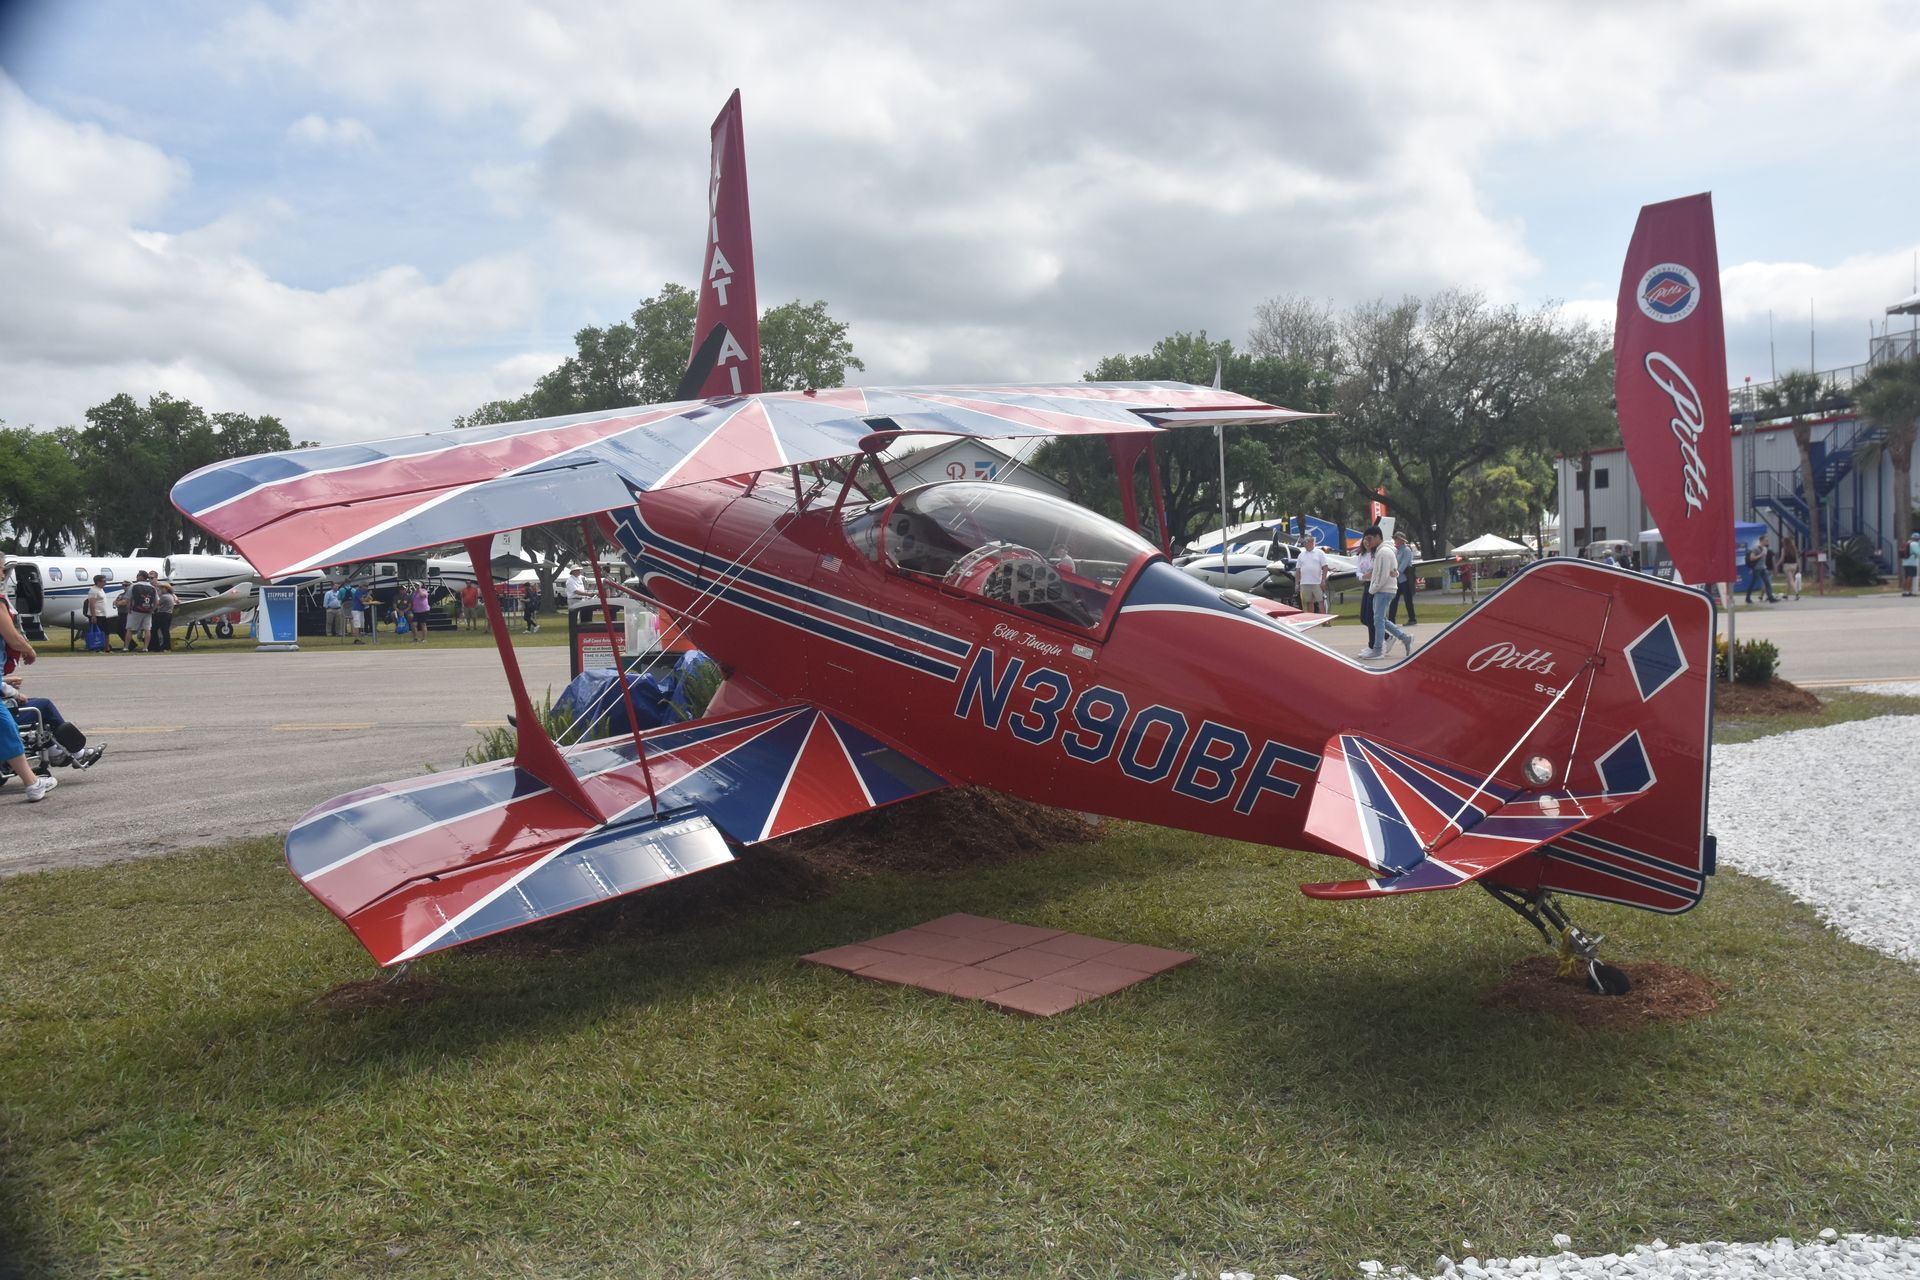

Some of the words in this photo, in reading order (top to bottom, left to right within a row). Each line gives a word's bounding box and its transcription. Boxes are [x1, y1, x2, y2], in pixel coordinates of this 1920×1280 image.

[1644, 351, 1710, 519] Pitts
[993, 623, 1020, 641] Bill
[1466, 641, 1557, 677] Pitts
[954, 647, 1322, 816] N390BF
